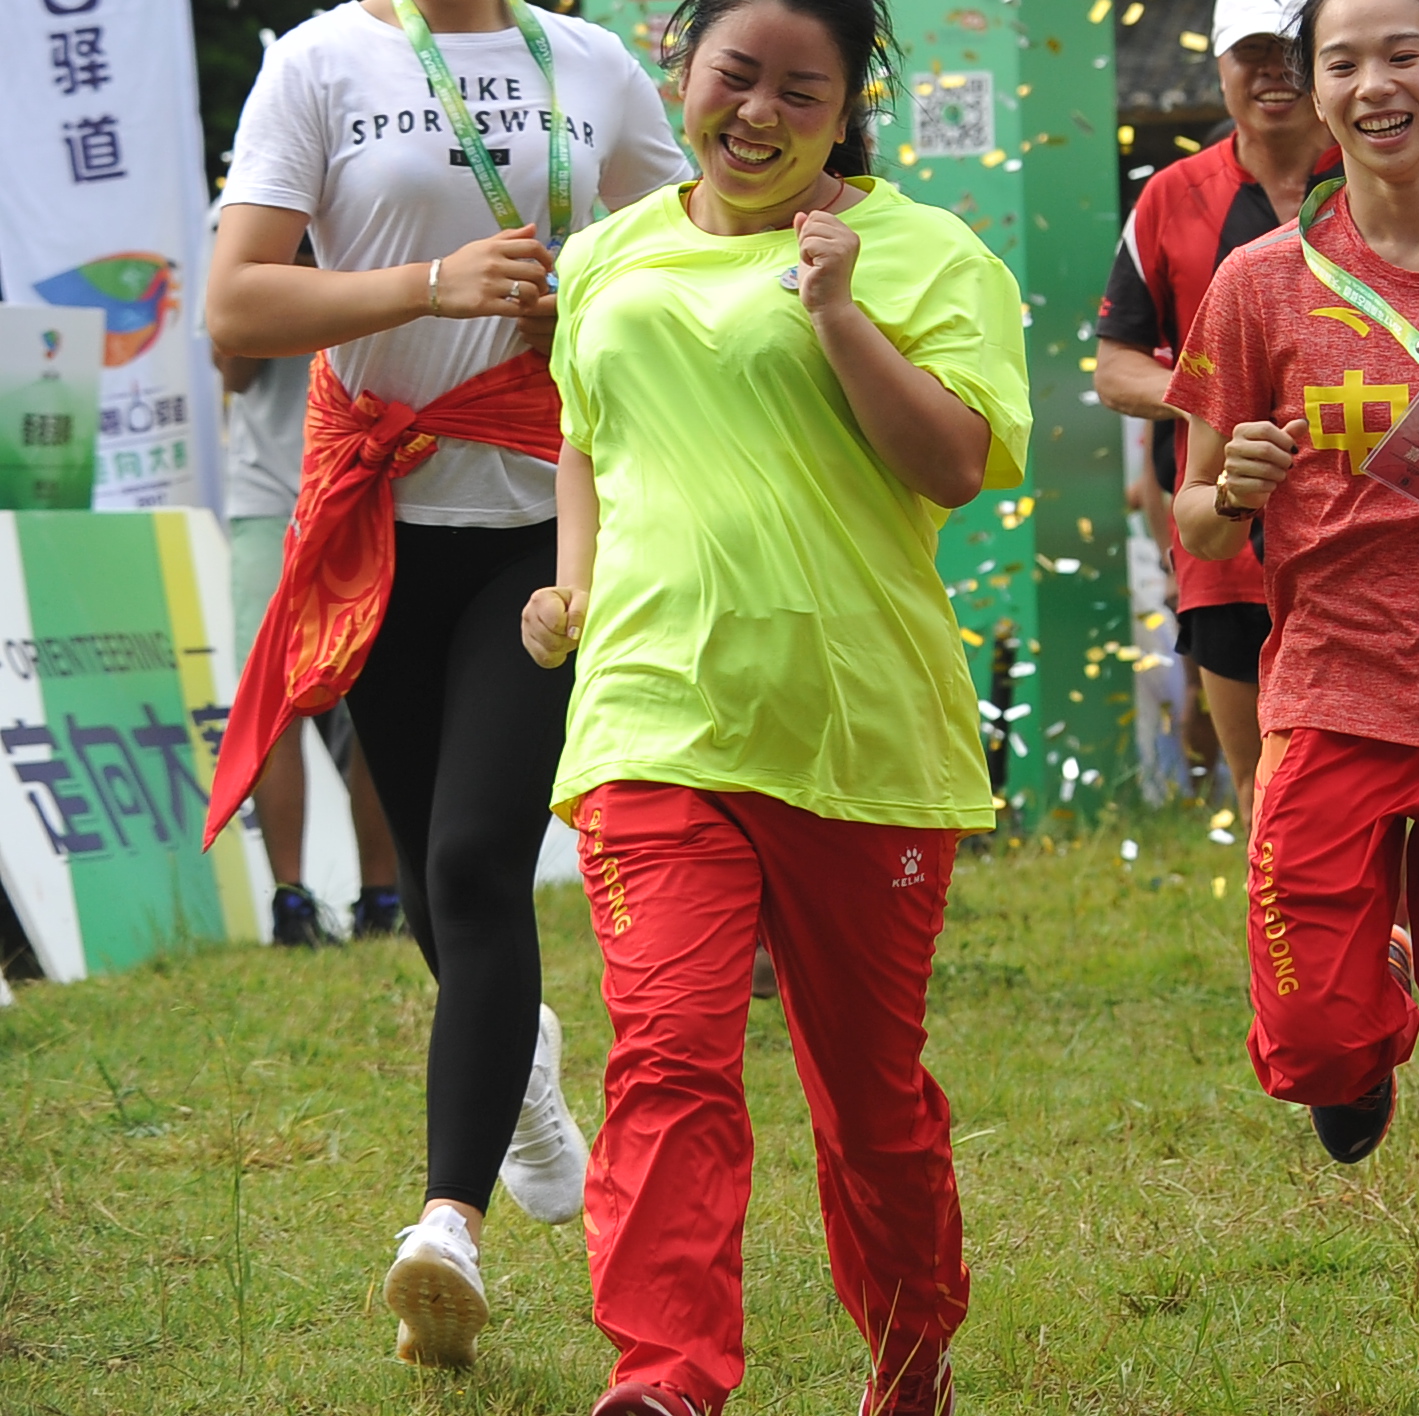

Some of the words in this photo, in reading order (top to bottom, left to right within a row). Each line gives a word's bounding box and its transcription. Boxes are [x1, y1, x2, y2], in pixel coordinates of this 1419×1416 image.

[352, 109, 594, 148] SPORSWEAR
[0, 703, 258, 856] 定向大
[891, 872, 926, 888] KELME
[1259, 841, 1299, 996] GUANGDONG
